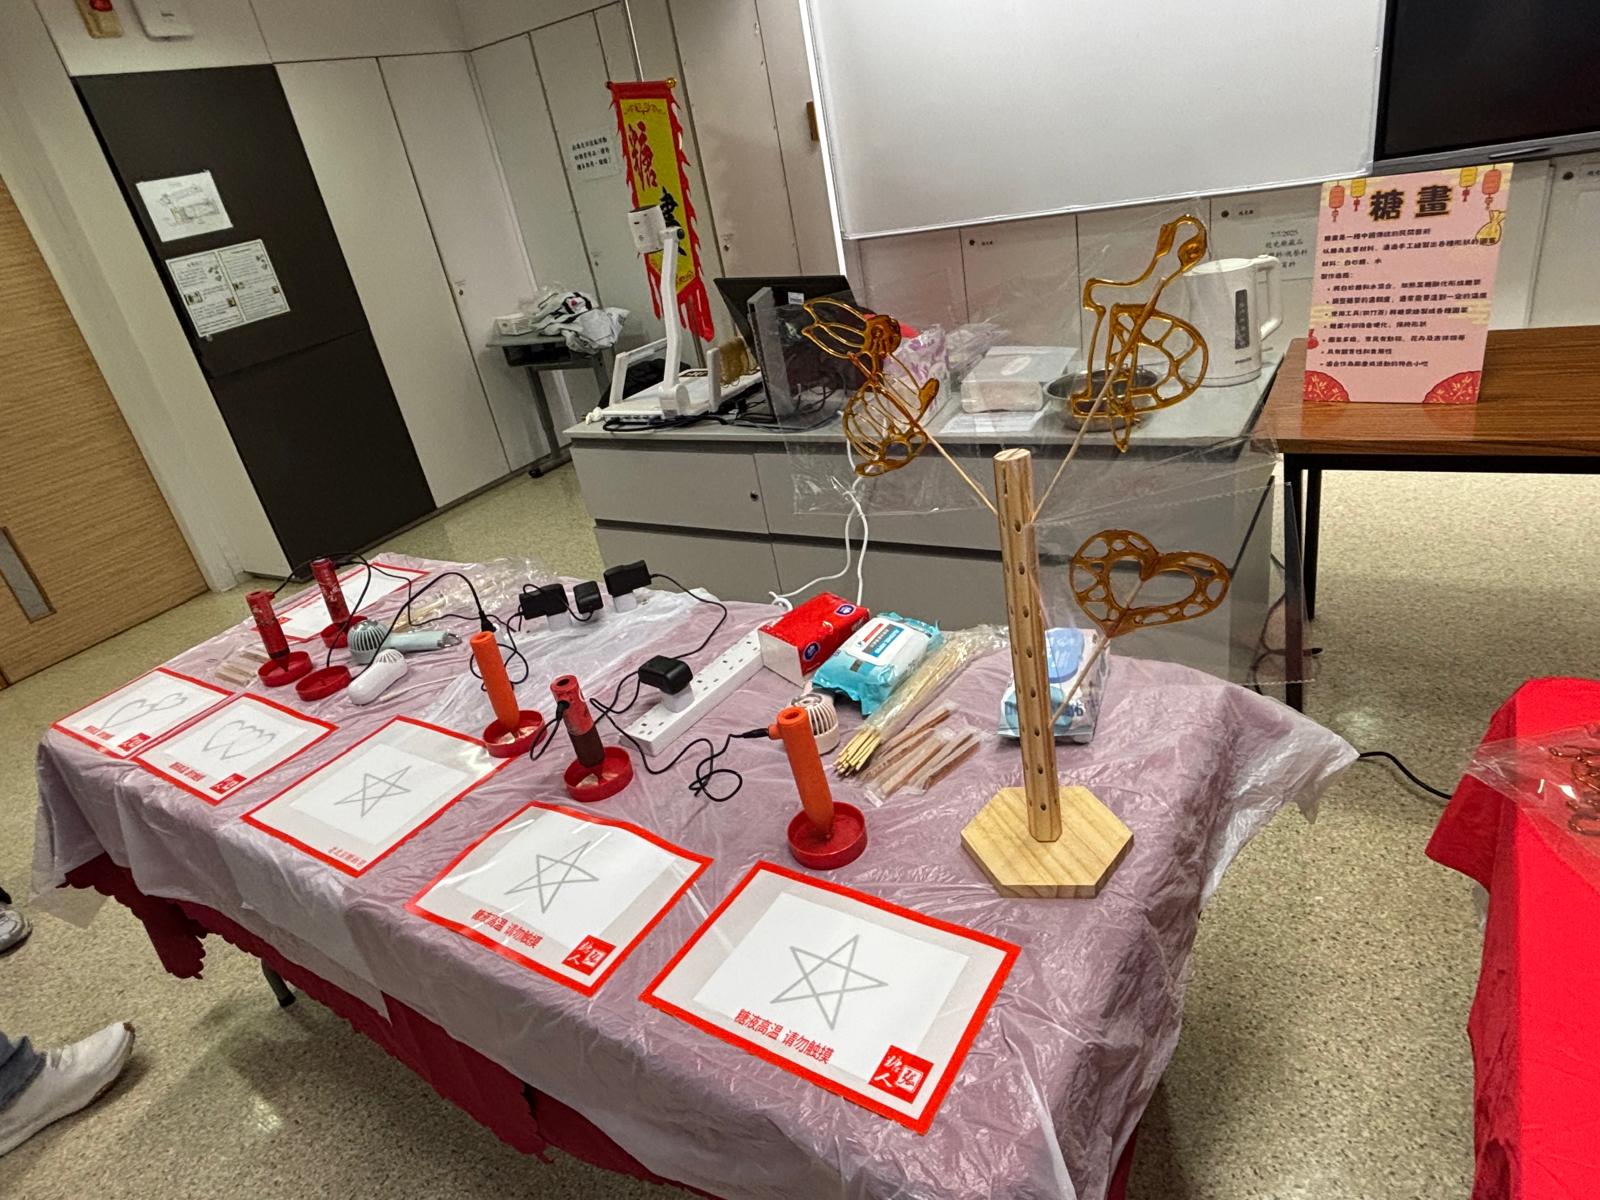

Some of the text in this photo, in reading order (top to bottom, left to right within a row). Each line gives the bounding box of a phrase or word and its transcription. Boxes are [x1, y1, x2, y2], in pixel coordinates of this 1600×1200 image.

[1369, 185, 1453, 221] 糖畫
[734, 1008, 835, 1065] 糖液高温 请勿触摸
